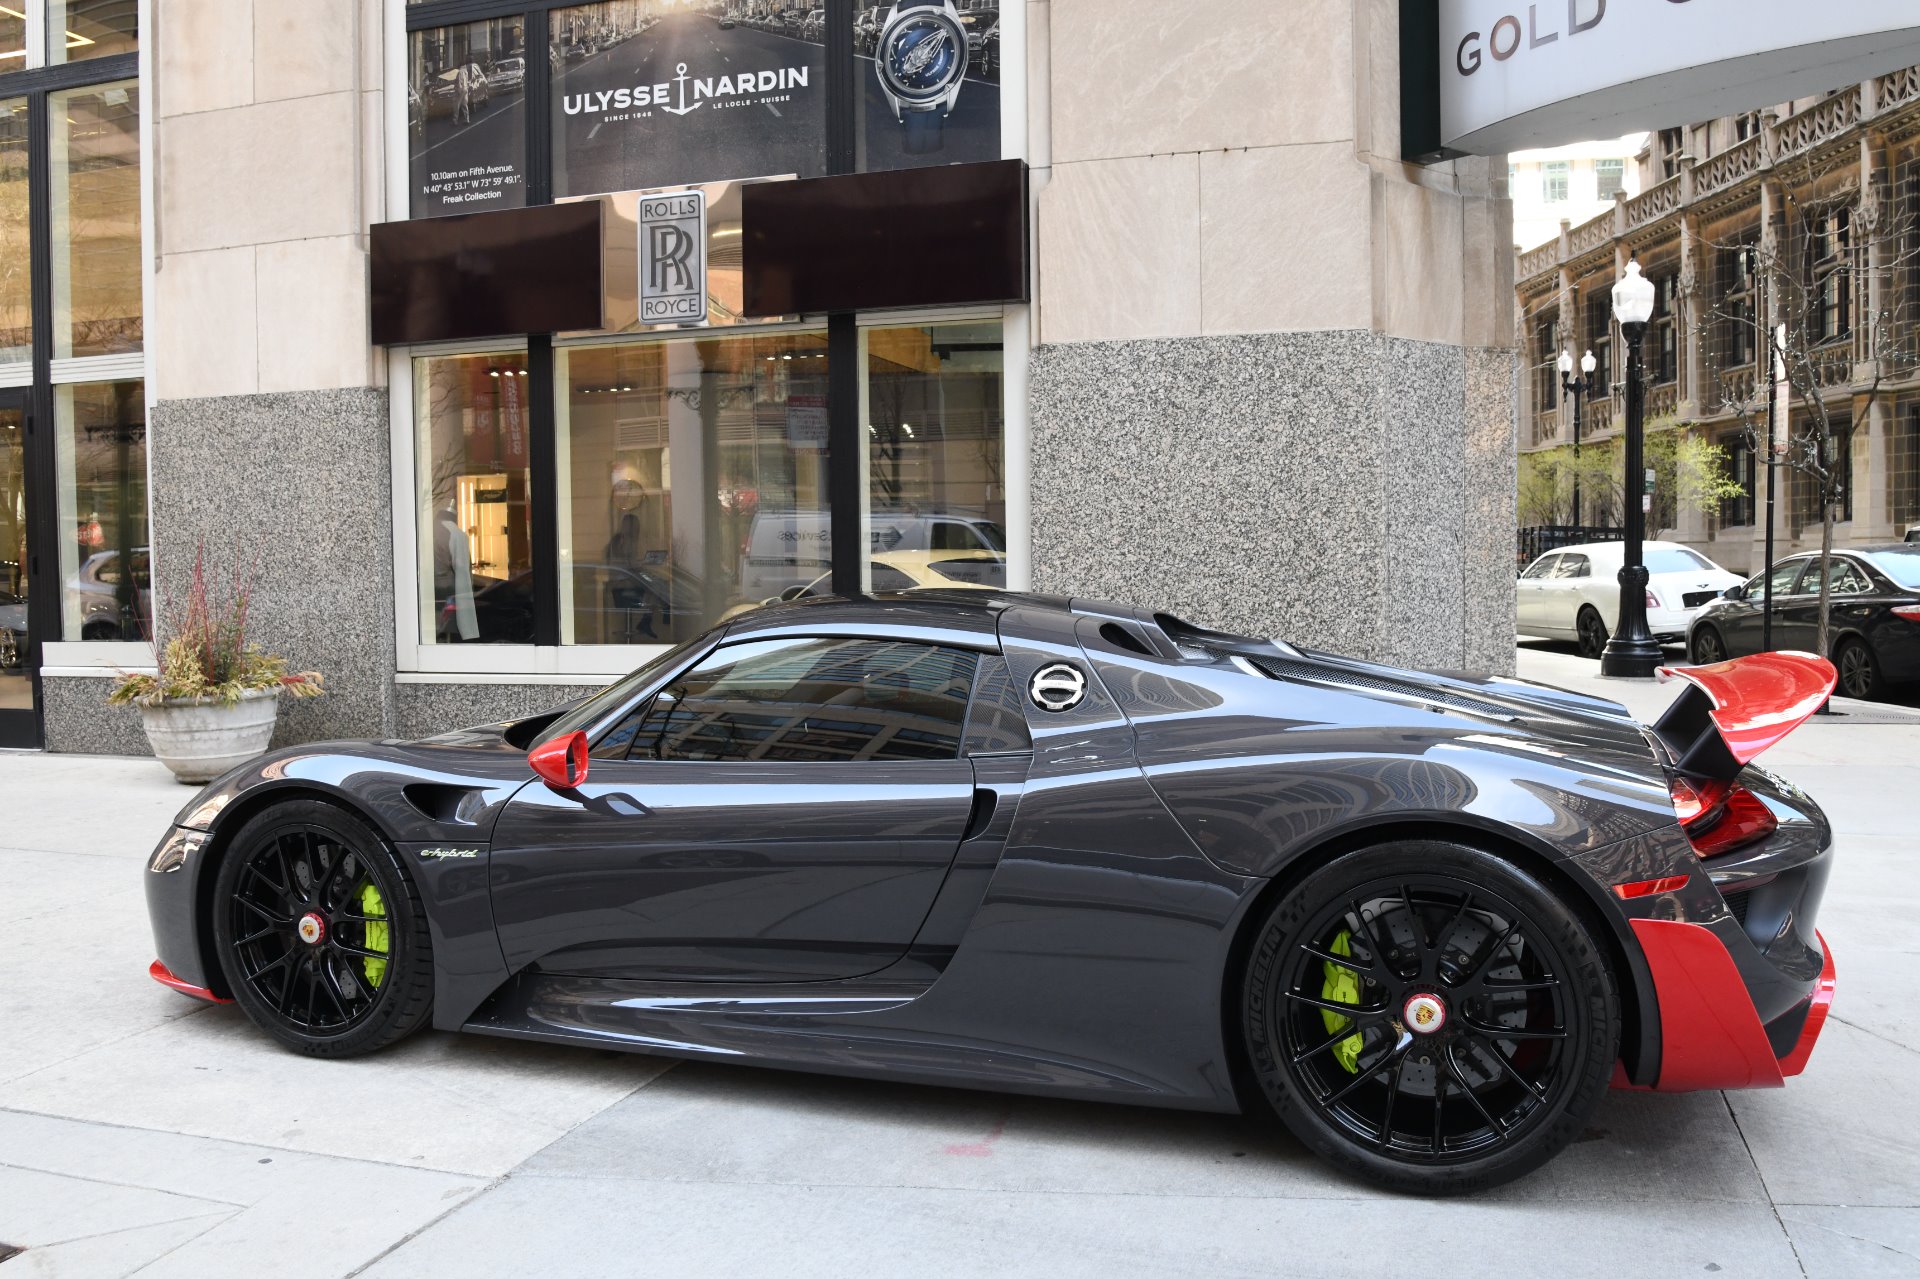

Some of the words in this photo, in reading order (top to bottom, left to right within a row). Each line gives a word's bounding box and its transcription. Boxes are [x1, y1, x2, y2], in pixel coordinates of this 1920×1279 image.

[1456, 0, 1606, 76] GOLD
[563, 82, 670, 115] ULYSSE
[693, 65, 808, 99] NARDIN
[725, 99, 751, 108] LOCLE
[760, 95, 790, 104] SUISSE
[604, 113, 629, 123] SINCE
[431, 171, 458, 181] 10.10am
[458, 170, 468, 178] on
[469, 166, 485, 176] Fifth
[486, 164, 514, 174] Avenue.
[423, 186, 429, 194] N
[471, 180, 480, 188] W
[442, 195, 464, 204] Freak
[464, 191, 502, 202] Collection
[644, 199, 696, 218] ROLLS
[645, 298, 697, 315] ROYCE
[420, 847, 478, 861] e-hybrid
[1248, 924, 1287, 1043] MICHELIN
